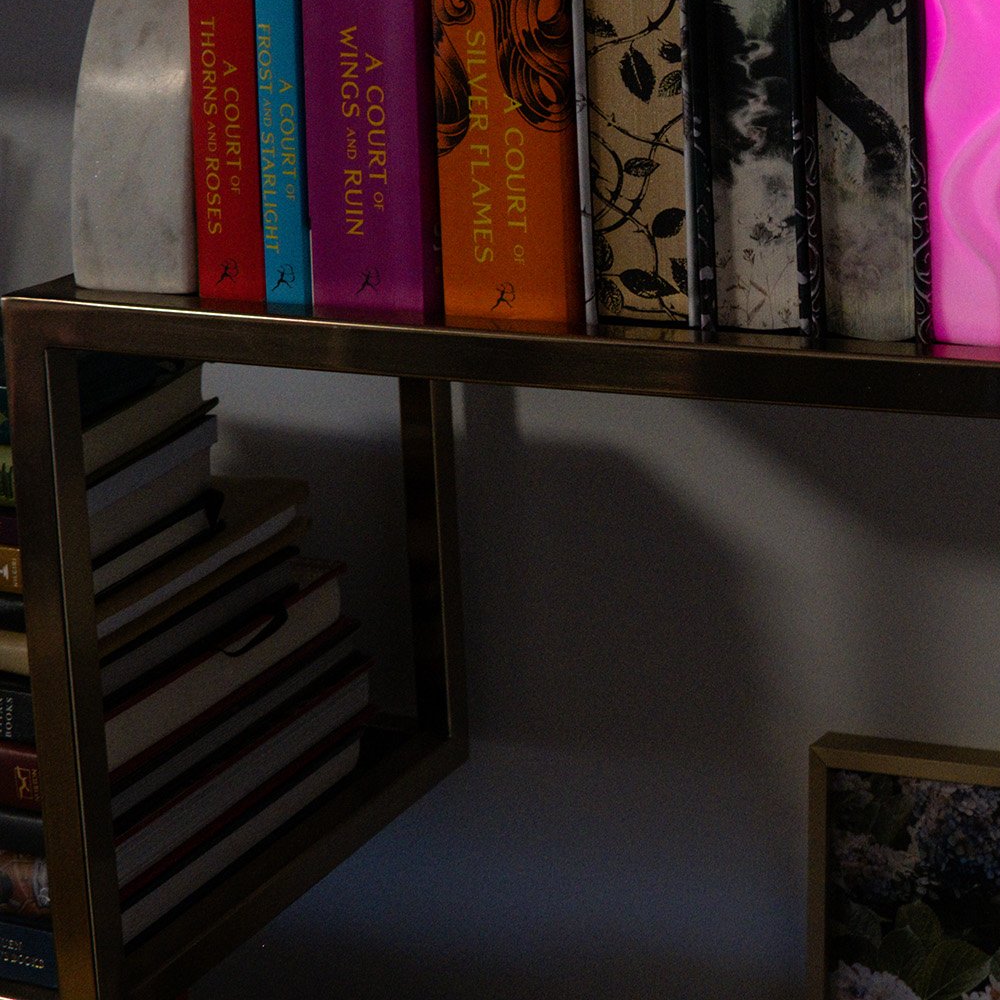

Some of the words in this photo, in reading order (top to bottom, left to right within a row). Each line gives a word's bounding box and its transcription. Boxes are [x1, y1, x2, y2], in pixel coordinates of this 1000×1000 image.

[200, 16, 218, 117] THORNS
[222, 60, 238, 76] A
[257, 23, 273, 94] FROST
[278, 79, 293, 94] A
[339, 25, 360, 118] WINGS
[365, 53, 383, 73] A
[466, 30, 489, 131] SILVER
[206, 121, 217, 153] AND
[223, 87, 242, 171] COURT
[263, 99, 273, 128] AND
[366, 84, 387, 185] COURT
[503, 93, 523, 114] A
[279, 103, 296, 179] COURT
[346, 128, 357, 160] AND
[205, 157, 222, 236] ROSES
[230, 175, 241, 195] OF
[261, 132, 281, 254] STARLIGHT
[343, 169, 365, 237] RUIN
[373, 191, 385, 212] OF
[470, 144, 494, 264] FLAMES
[504, 127, 527, 233] COURT
[514, 244, 525, 266] OF
